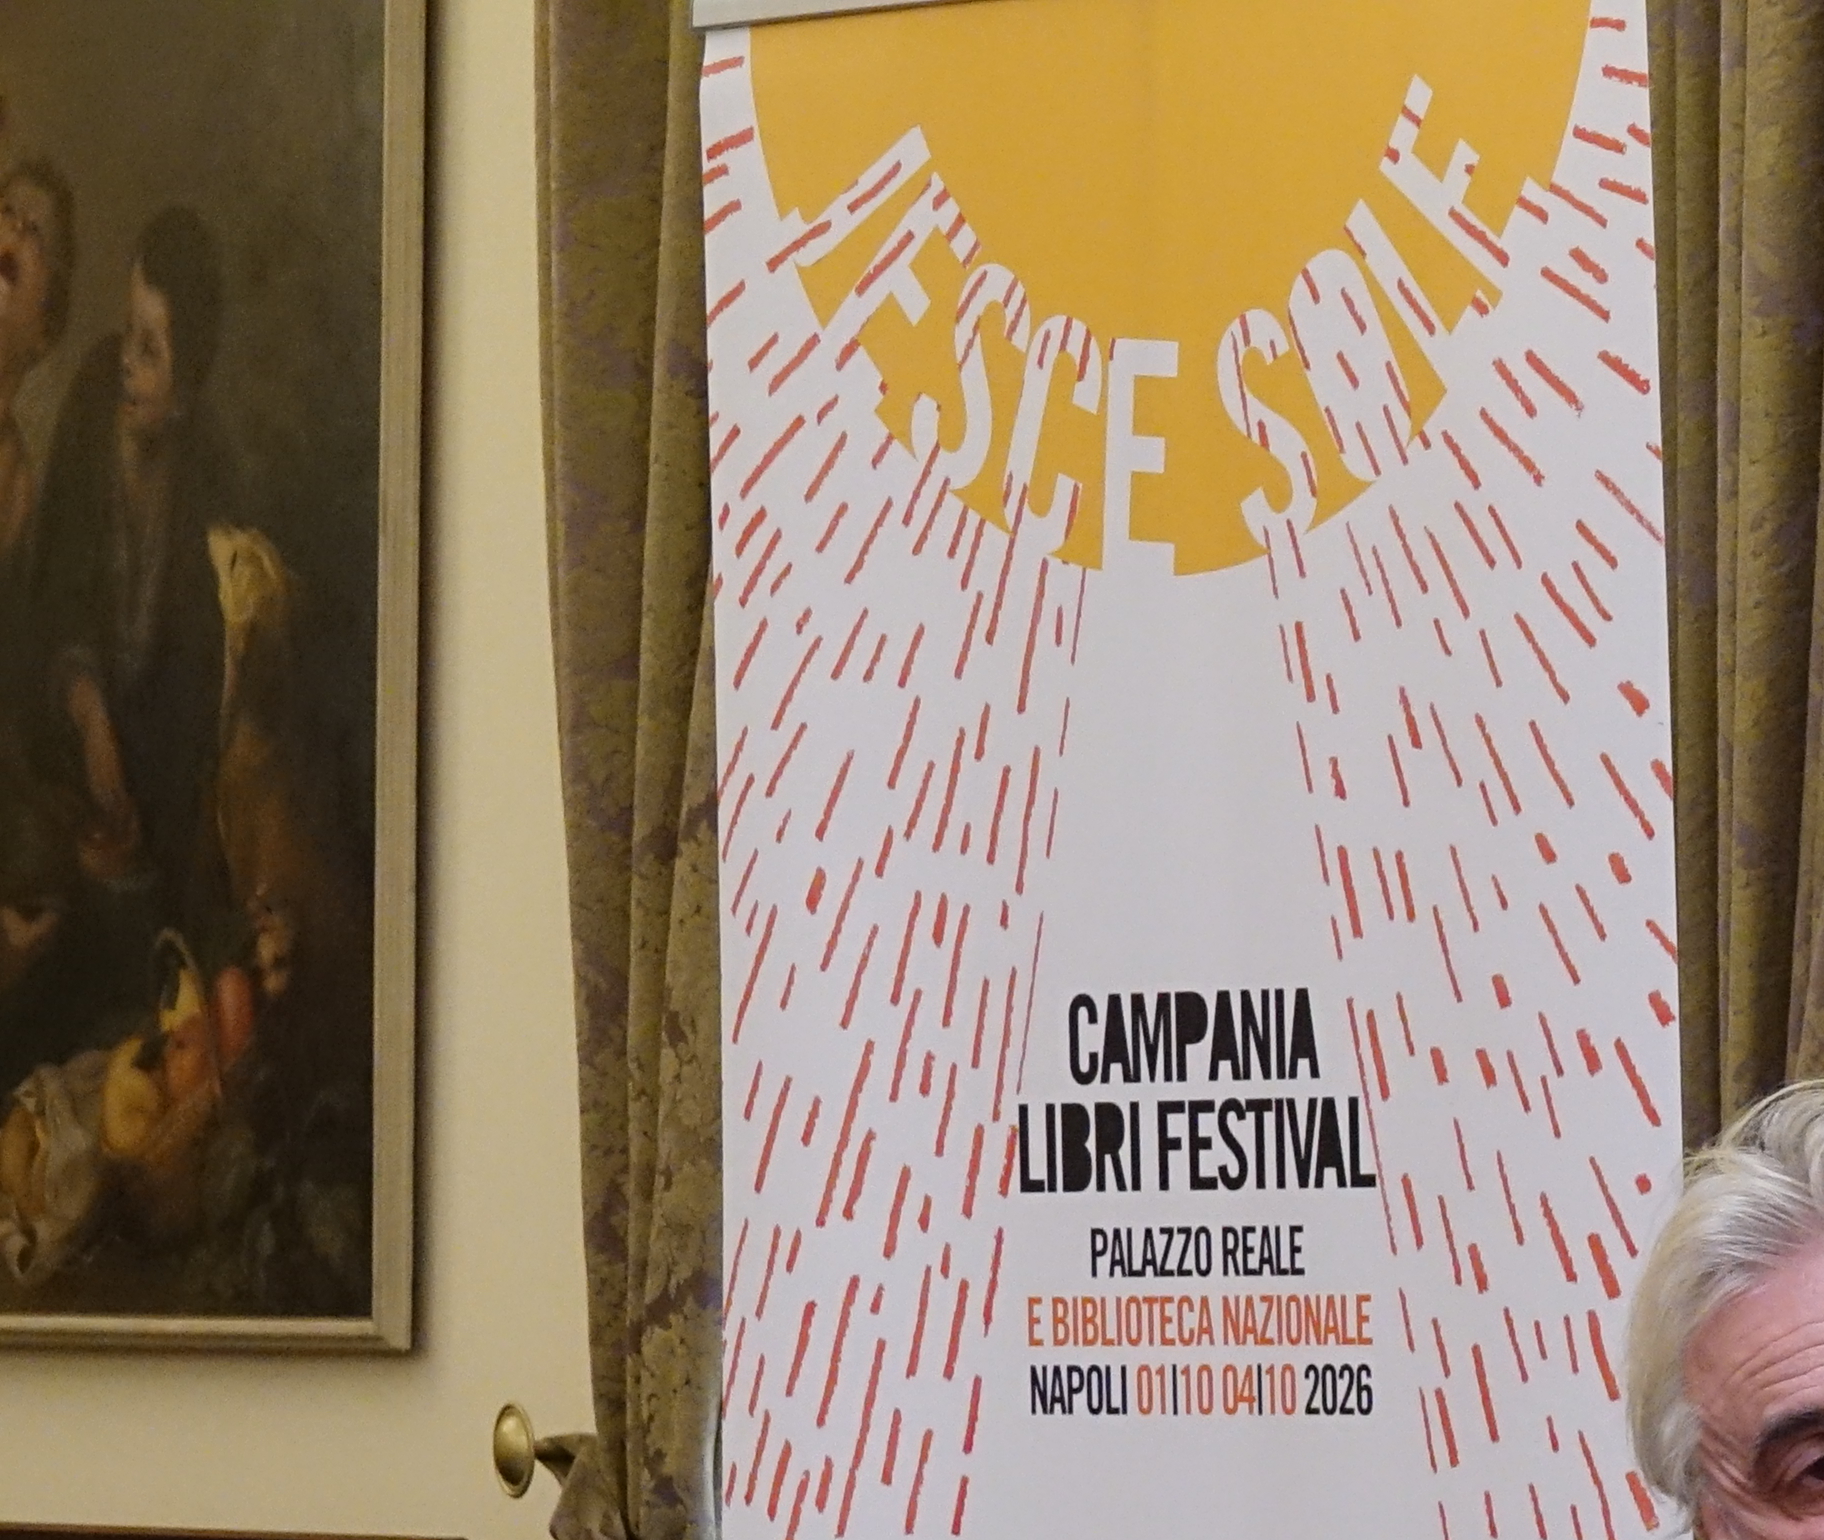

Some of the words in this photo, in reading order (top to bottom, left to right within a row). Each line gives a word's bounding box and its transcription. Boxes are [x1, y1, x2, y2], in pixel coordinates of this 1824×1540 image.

[1068, 987, 1321, 1086] CAMPANIA
[1017, 1101, 1142, 1193] LIBRI
[1157, 1096, 1377, 1191] FESTIVAL
[1090, 1225, 1213, 1278] PALAZZO
[1221, 1224, 1306, 1277] REALE
[1027, 1296, 1044, 1347] E
[1051, 1295, 1215, 1347] BIBLIOTECA
[1222, 1294, 1374, 1346] NAZIONALE
[1029, 1364, 1128, 1416] NAPOLI
[1304, 1363, 1374, 1416] 2026
